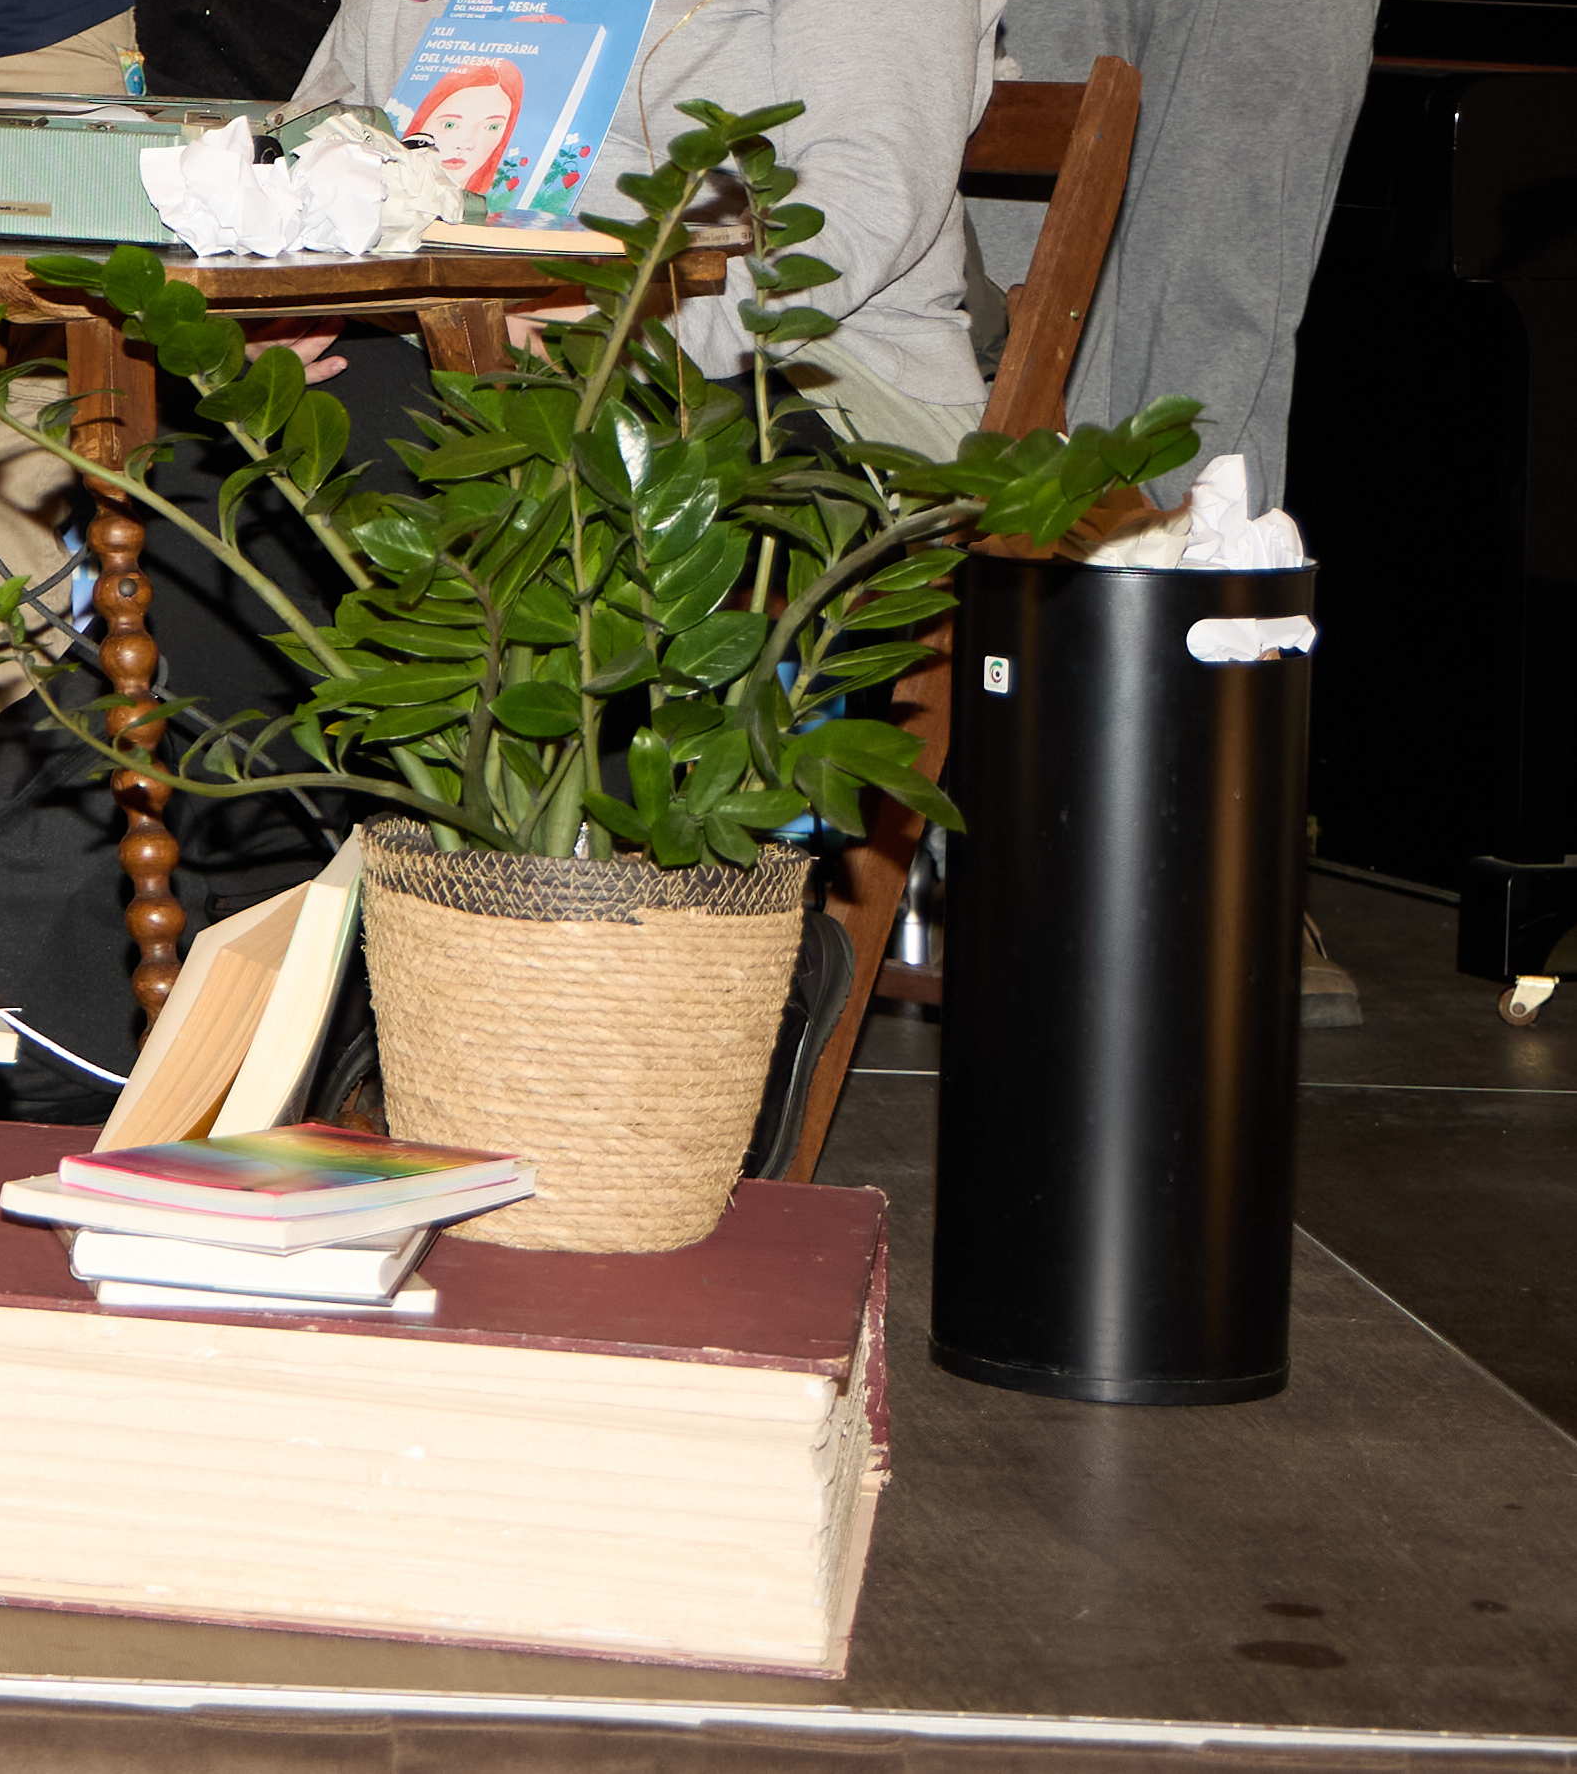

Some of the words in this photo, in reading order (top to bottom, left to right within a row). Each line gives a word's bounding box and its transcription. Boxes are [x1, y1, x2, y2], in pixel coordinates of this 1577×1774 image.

[453, 4, 469, 12] DEL
[469, 5, 505, 13] MARESME
[506, 1, 548, 13] RESME
[431, 26, 455, 37] XLII
[425, 39, 476, 52] MOSTRA
[478, 41, 540, 55] LITERÀRIA
[418, 53, 440, 64] DEL
[442, 54, 504, 68] MARESME
[414, 65, 439, 73] CANET
